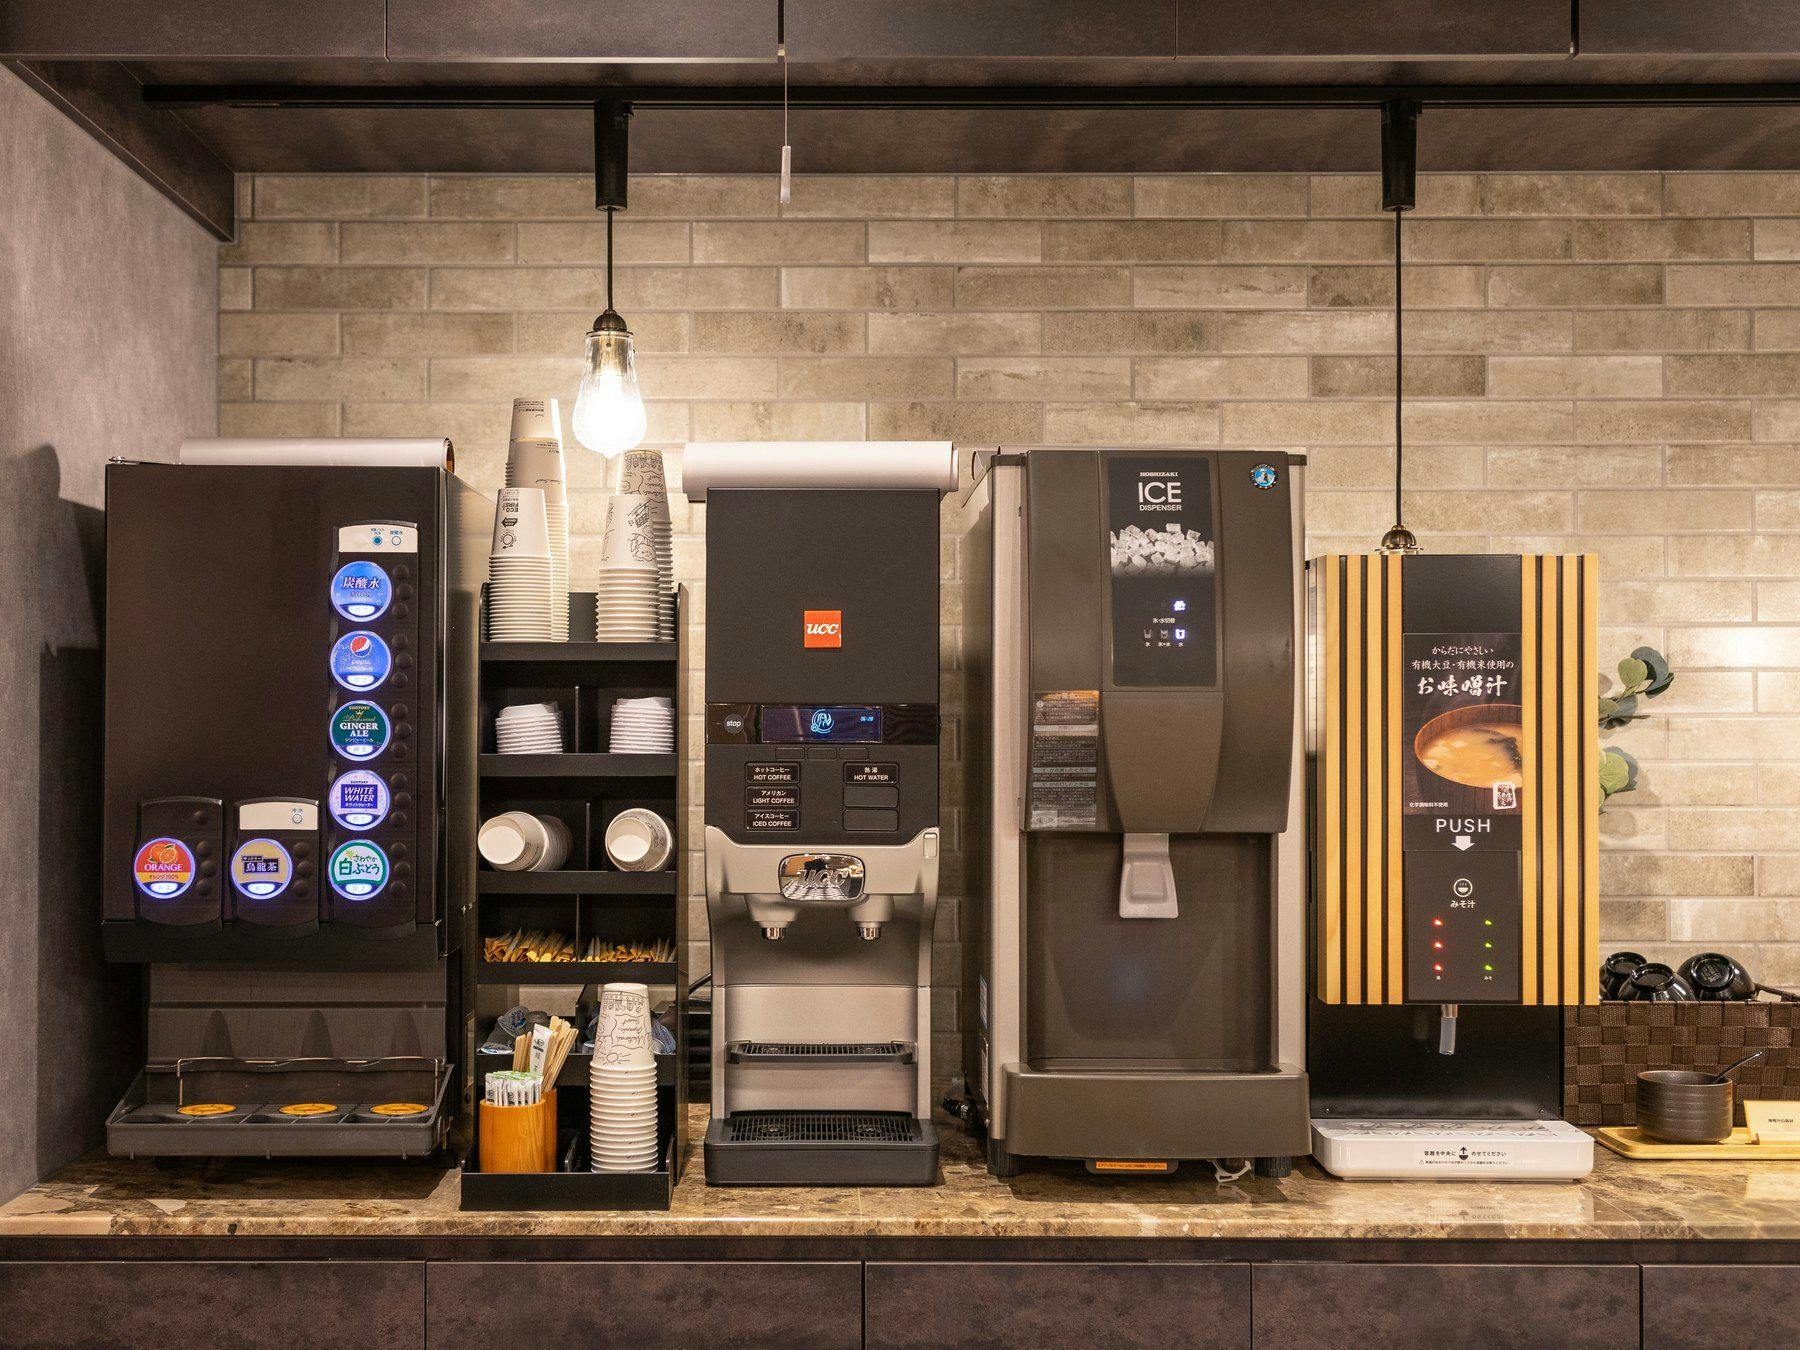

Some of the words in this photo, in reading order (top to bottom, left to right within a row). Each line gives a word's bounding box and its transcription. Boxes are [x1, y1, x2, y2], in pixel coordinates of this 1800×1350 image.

[1138, 481, 1182, 503] ICE
[342, 577, 379, 589] 炭酸水
[806, 623, 839, 635] ucc
[1432, 645, 1494, 655] からだにやさしい
[1411, 660, 1514, 670] 有機大豆・有機米使用の
[1417, 675, 1508, 697] お味噌汁
[340, 722, 379, 730] GINGER
[726, 720, 741, 729] stop
[344, 787, 375, 795] WHITE
[344, 794, 375, 802] WATER
[1436, 819, 1491, 833] PUSH
[352, 854, 378, 863] さわやか
[144, 863, 183, 872] ORANGE
[246, 861, 279, 872] 烏龍茶
[339, 858, 380, 876] 白ぶどう
[1450, 900, 1476, 909] みそ汁
